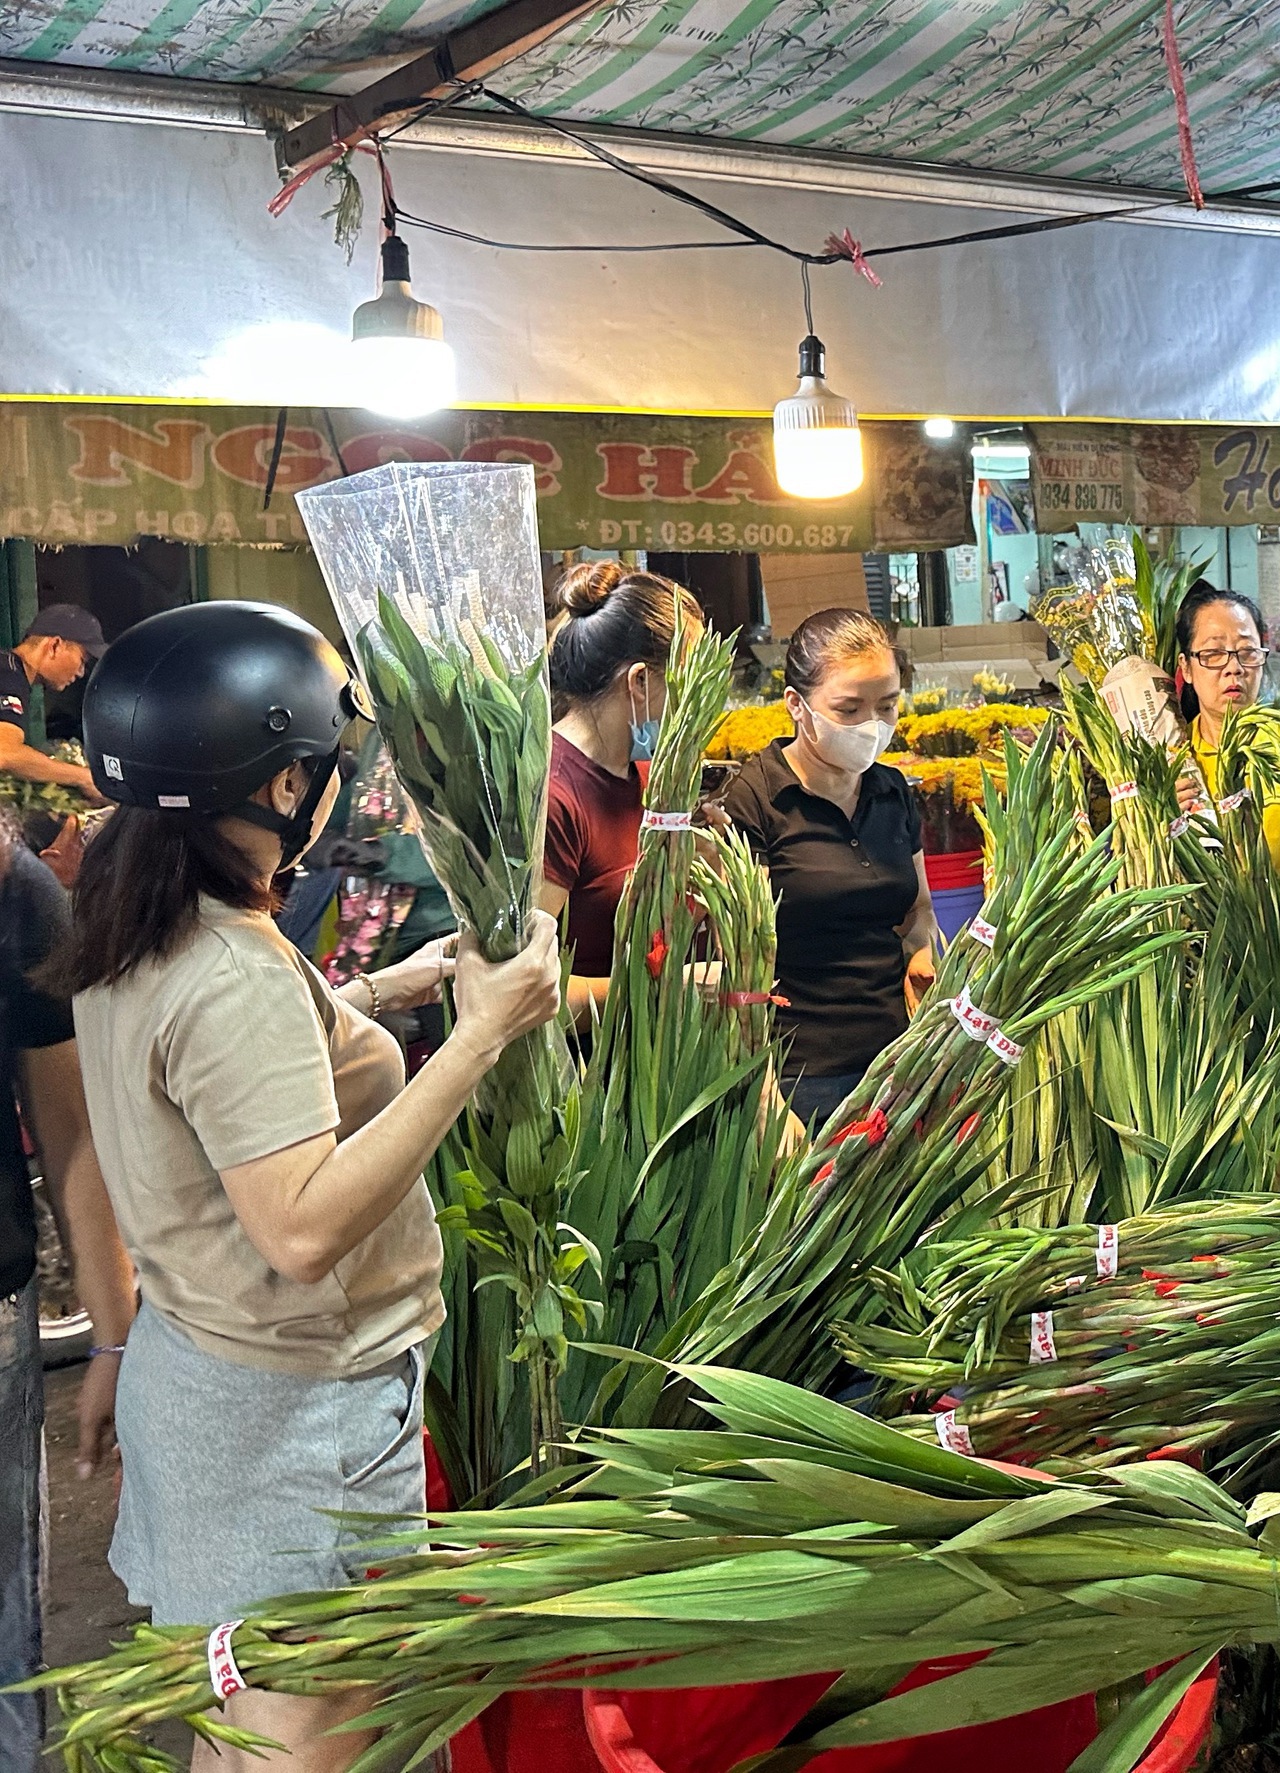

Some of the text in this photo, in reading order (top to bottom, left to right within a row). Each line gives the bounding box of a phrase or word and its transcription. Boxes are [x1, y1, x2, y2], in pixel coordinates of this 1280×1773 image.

[1100, 484, 1122, 510] 775
[135, 508, 242, 540] HOA
[600, 520, 854, 548] ĐT: 0343.600.687
[963, 1006, 991, 1031] Lạt
[996, 1037, 1018, 1056] Đà
[1037, 1332, 1053, 1361] Lạt
[217, 1662, 241, 1697] Đà
